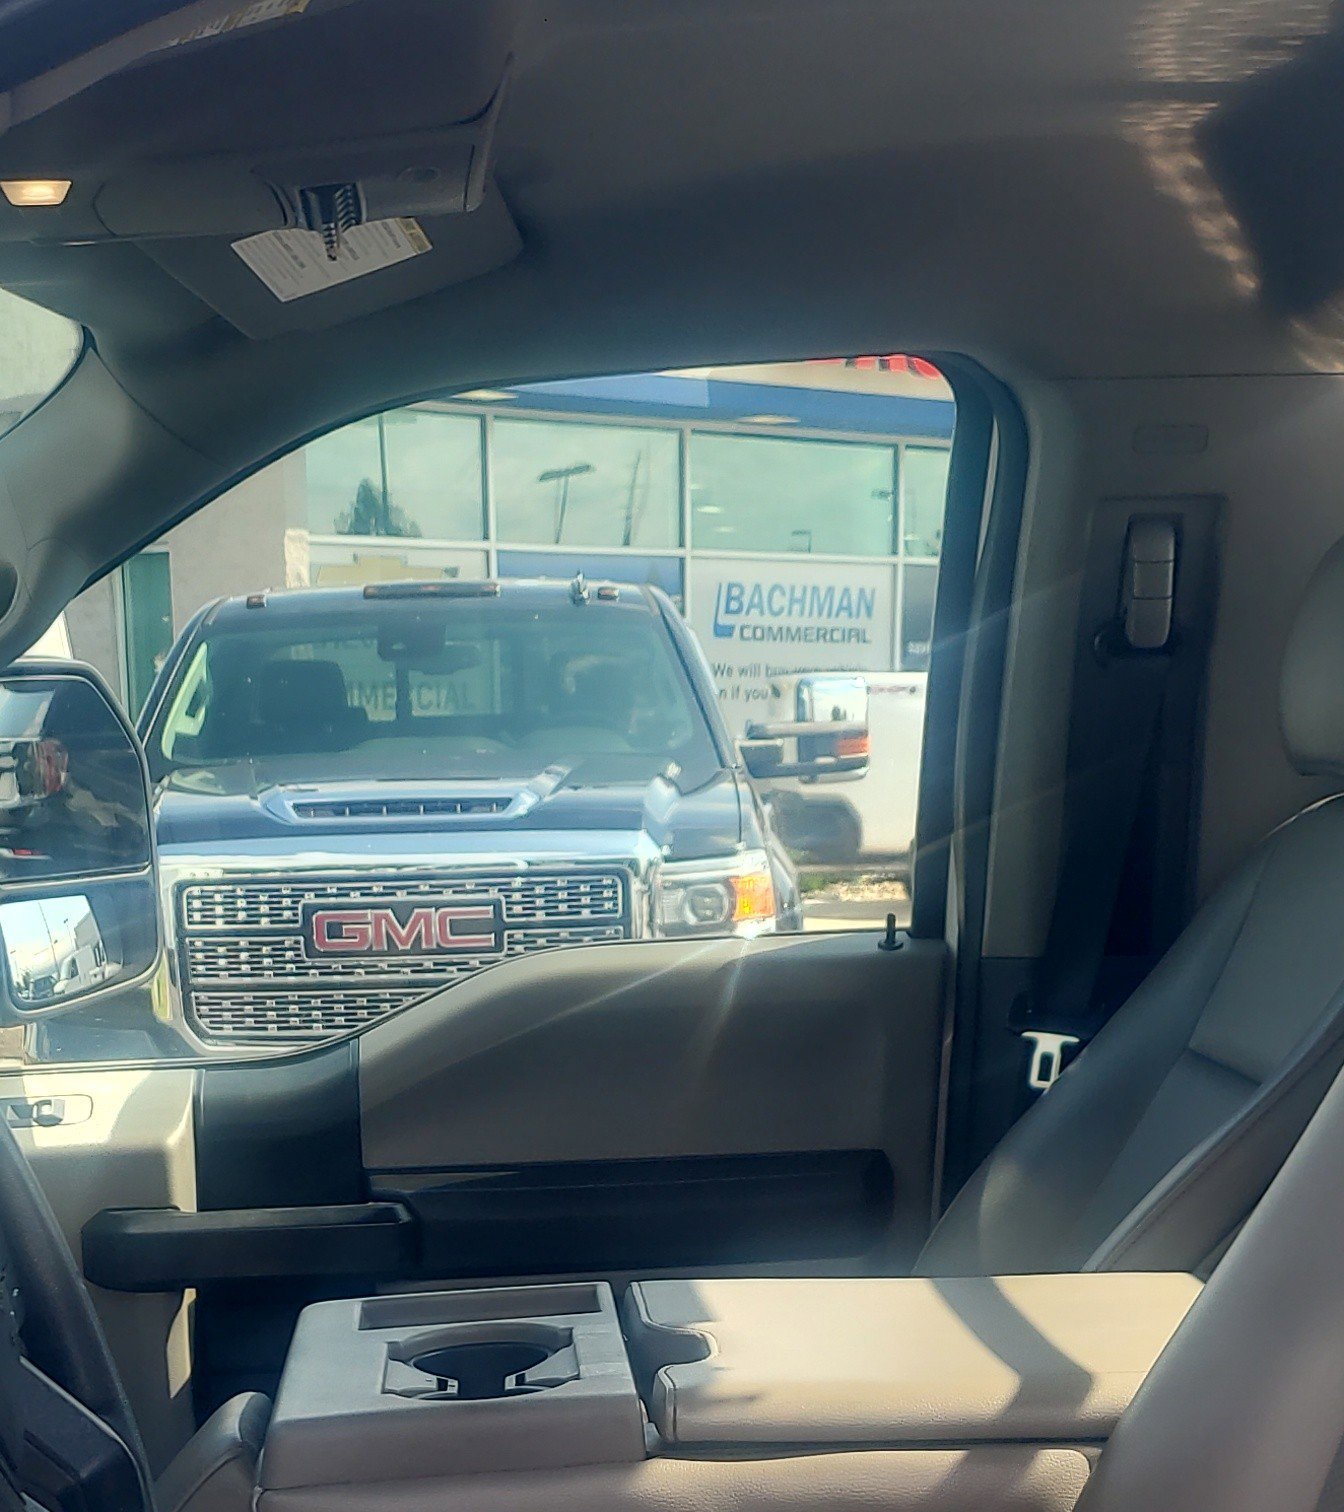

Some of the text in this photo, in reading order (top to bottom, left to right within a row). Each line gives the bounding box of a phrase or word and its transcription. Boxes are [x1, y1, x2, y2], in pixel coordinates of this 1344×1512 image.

[725, 582, 876, 619] BACHMAN
[739, 625, 872, 645] COMMERCIAL
[312, 904, 496, 951] GMC
